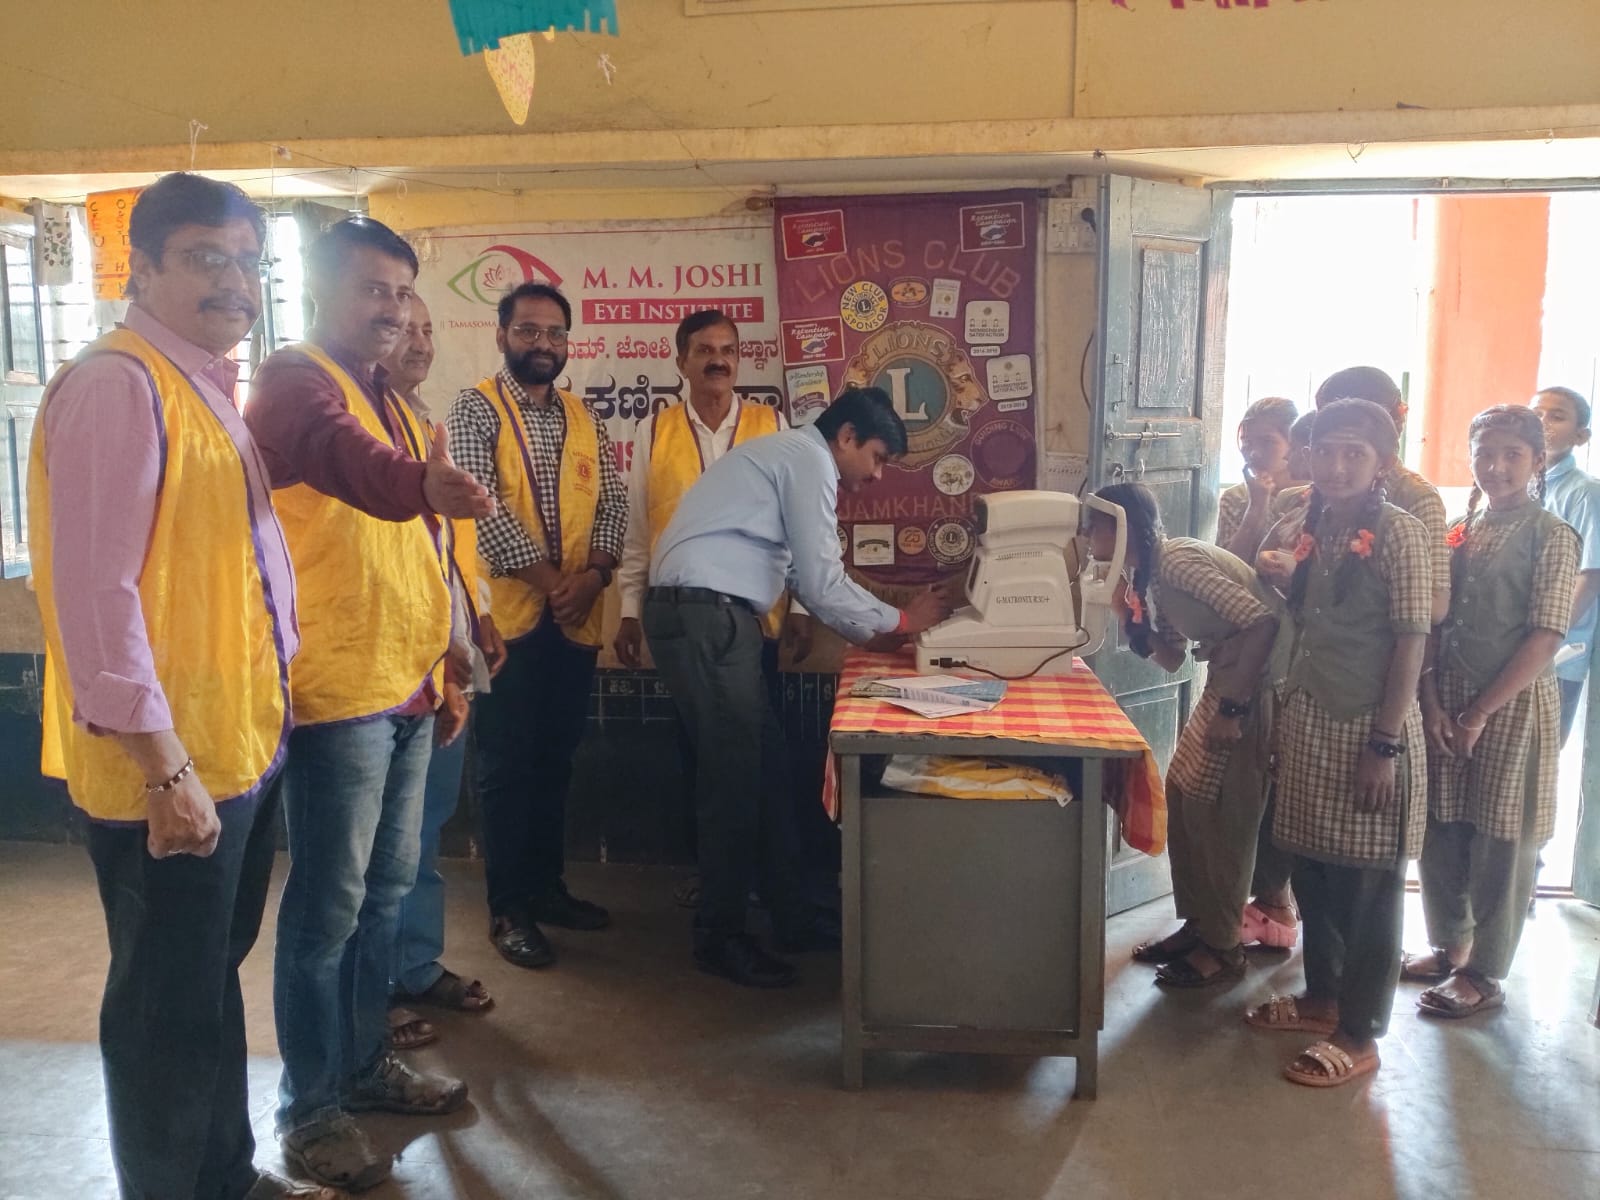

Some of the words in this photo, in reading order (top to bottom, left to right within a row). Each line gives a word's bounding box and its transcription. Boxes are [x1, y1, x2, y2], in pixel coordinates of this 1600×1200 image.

[582, 265, 618, 289] M.
[626, 265, 664, 289] M.
[672, 262, 763, 295] JOSHI
[795, 239, 906, 302] LIONS
[923, 240, 1022, 299] CLUB
[842, 285, 858, 311] NEW
[861, 282, 886, 304] CLUB
[845, 306, 888, 331] SPONSOR
[616, 335, 672, 360] ಜೋಶಿ
[739, 337, 778, 371] ಜ್ಞಾನ
[871, 332, 950, 360] LIONS
[886, 367, 929, 421] L
[974, 422, 1008, 446] GUIDING
[904, 528, 921, 543] 25
